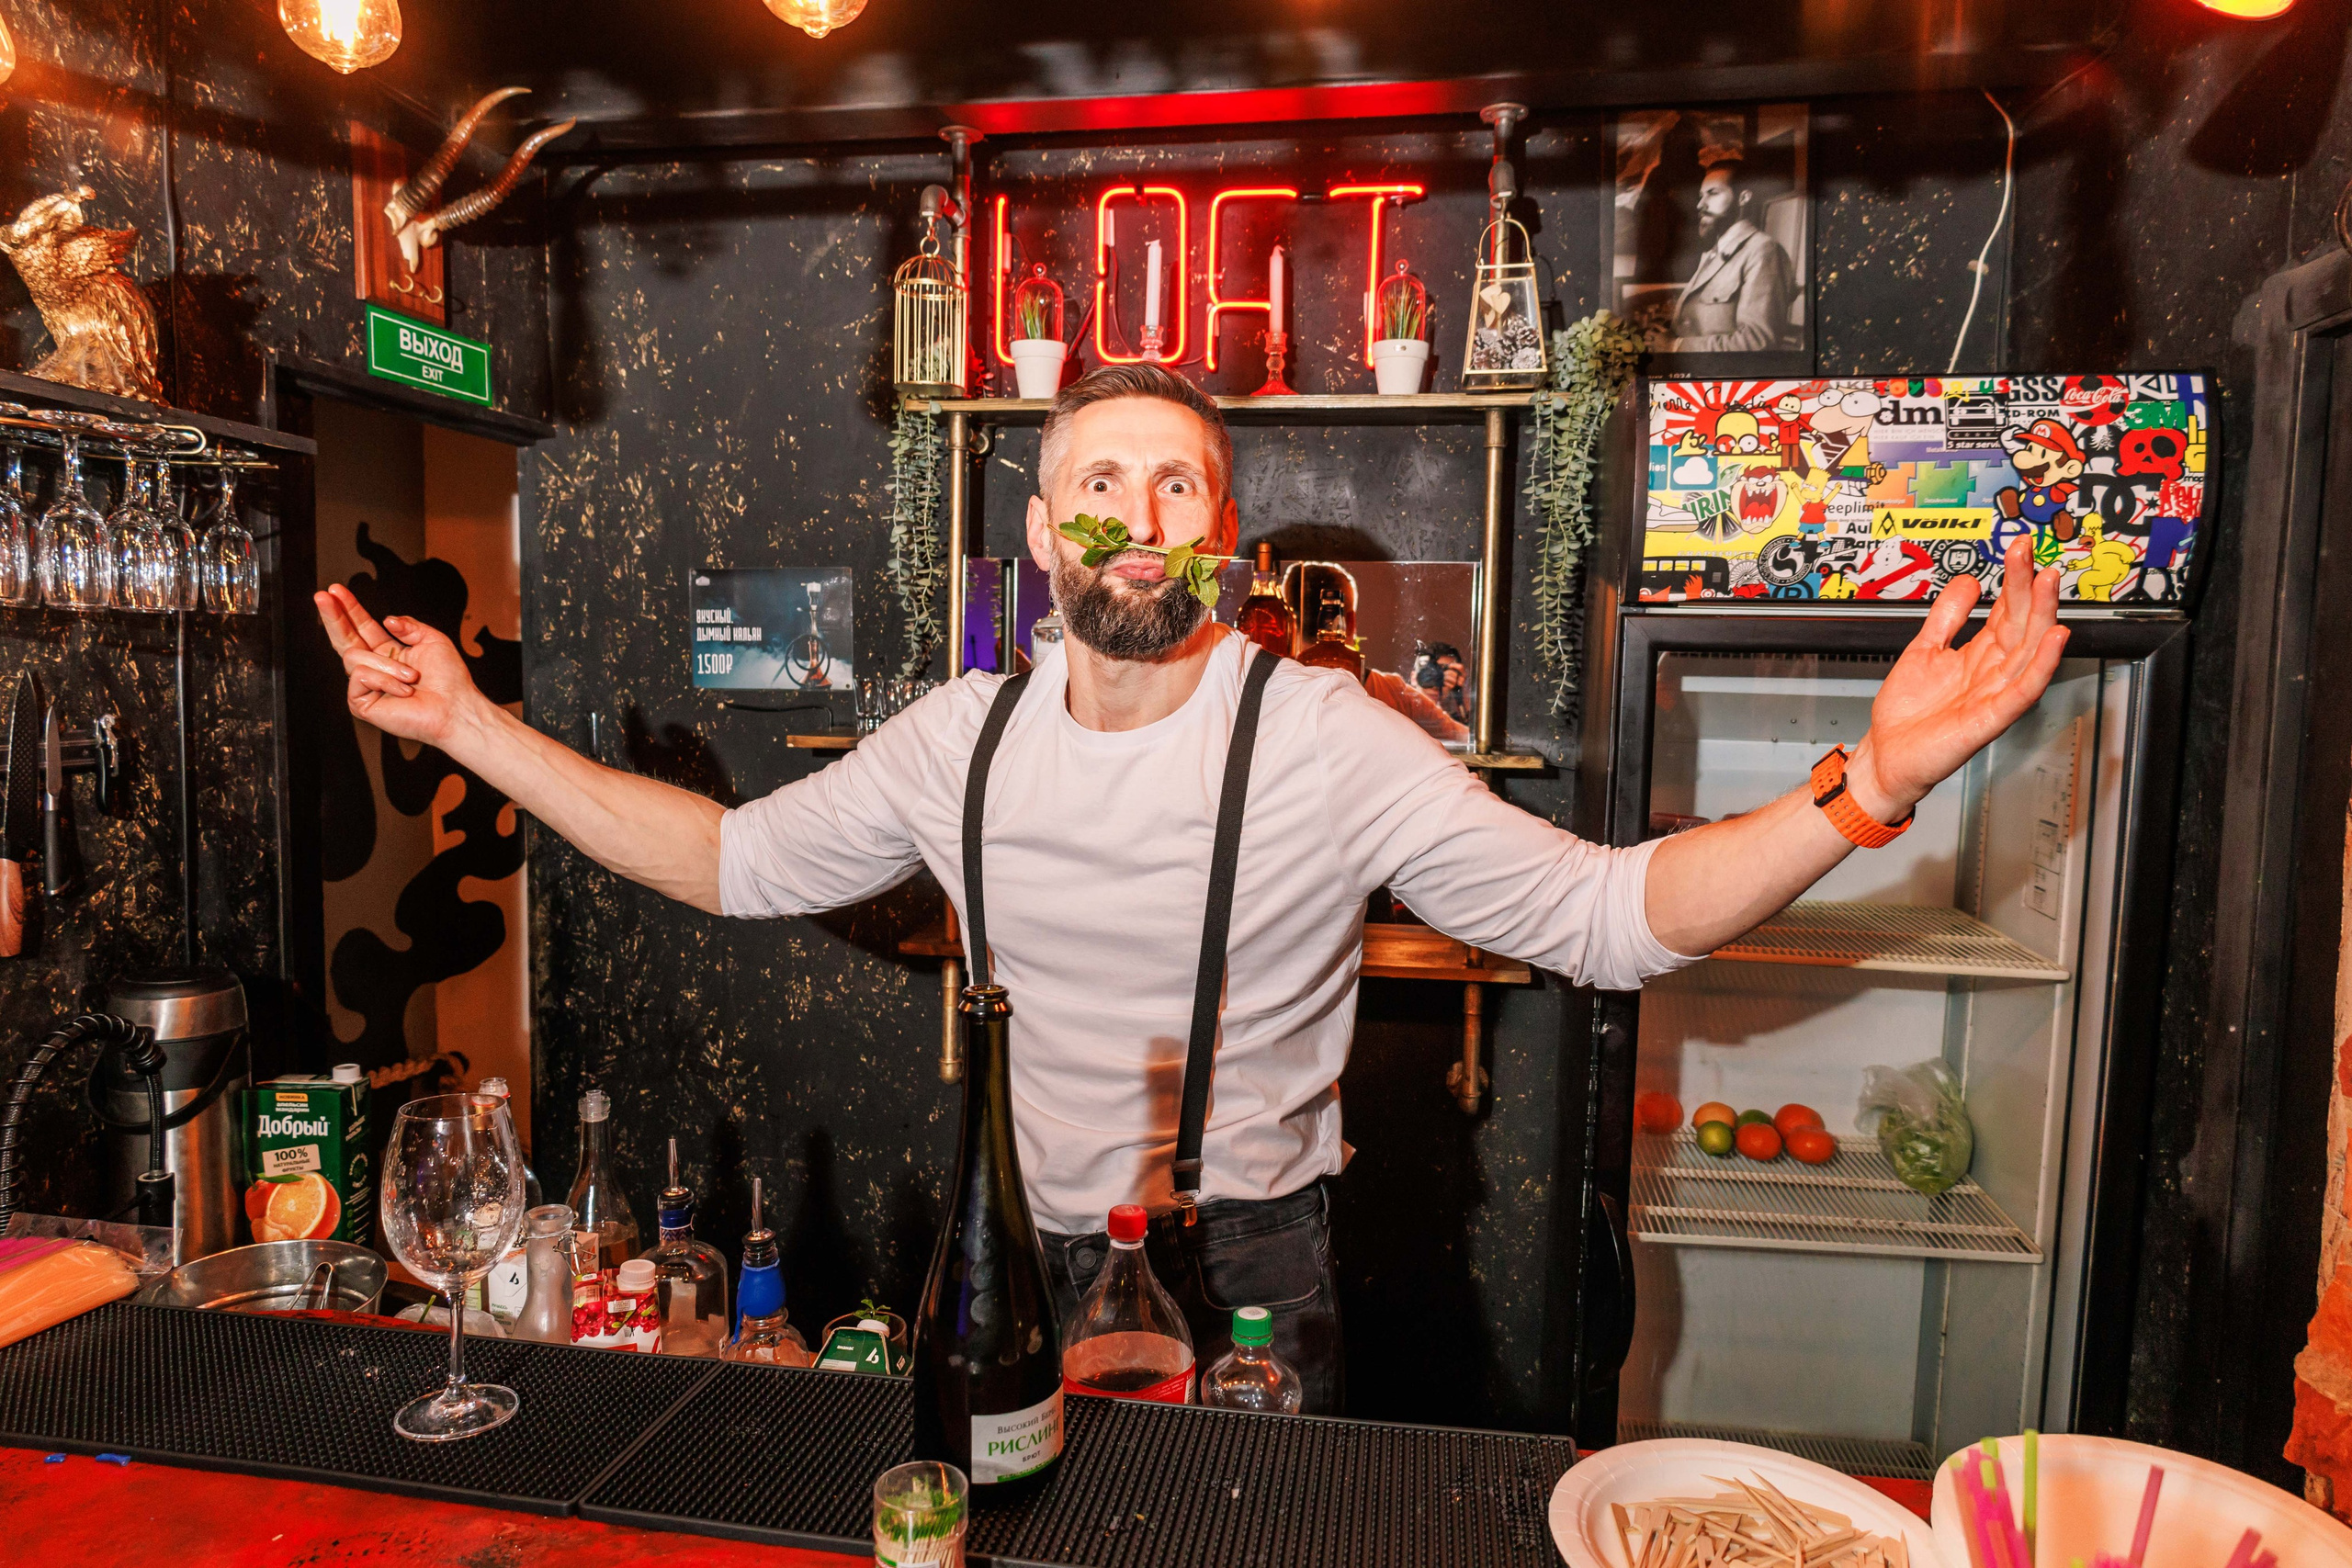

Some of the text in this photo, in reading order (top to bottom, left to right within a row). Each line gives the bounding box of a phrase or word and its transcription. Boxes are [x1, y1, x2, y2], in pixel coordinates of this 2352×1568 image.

[994, 185, 1424, 373] LOFT
[399, 327, 464, 373] ВЫХОД
[422, 365, 444, 382] EXIT
[2063, 386, 2129, 405] Coca-Cola
[1874, 400, 1945, 426] dm
[2124, 401, 2188, 430] 3M
[1955, 441, 1974, 449] star
[1902, 517, 1983, 530] Völkl
[695, 626, 763, 642] ДЫМНЫЙ КАЛЬЯН
[257, 1115, 329, 1138] Добрый
[274, 1147, 309, 1162] 100%
[281, 1165, 304, 1173] ФРУКТЫ
[988, 1416, 1061, 1456] РИСЛИНГ
[1022, 1450, 1042, 1463] БРЮТ
